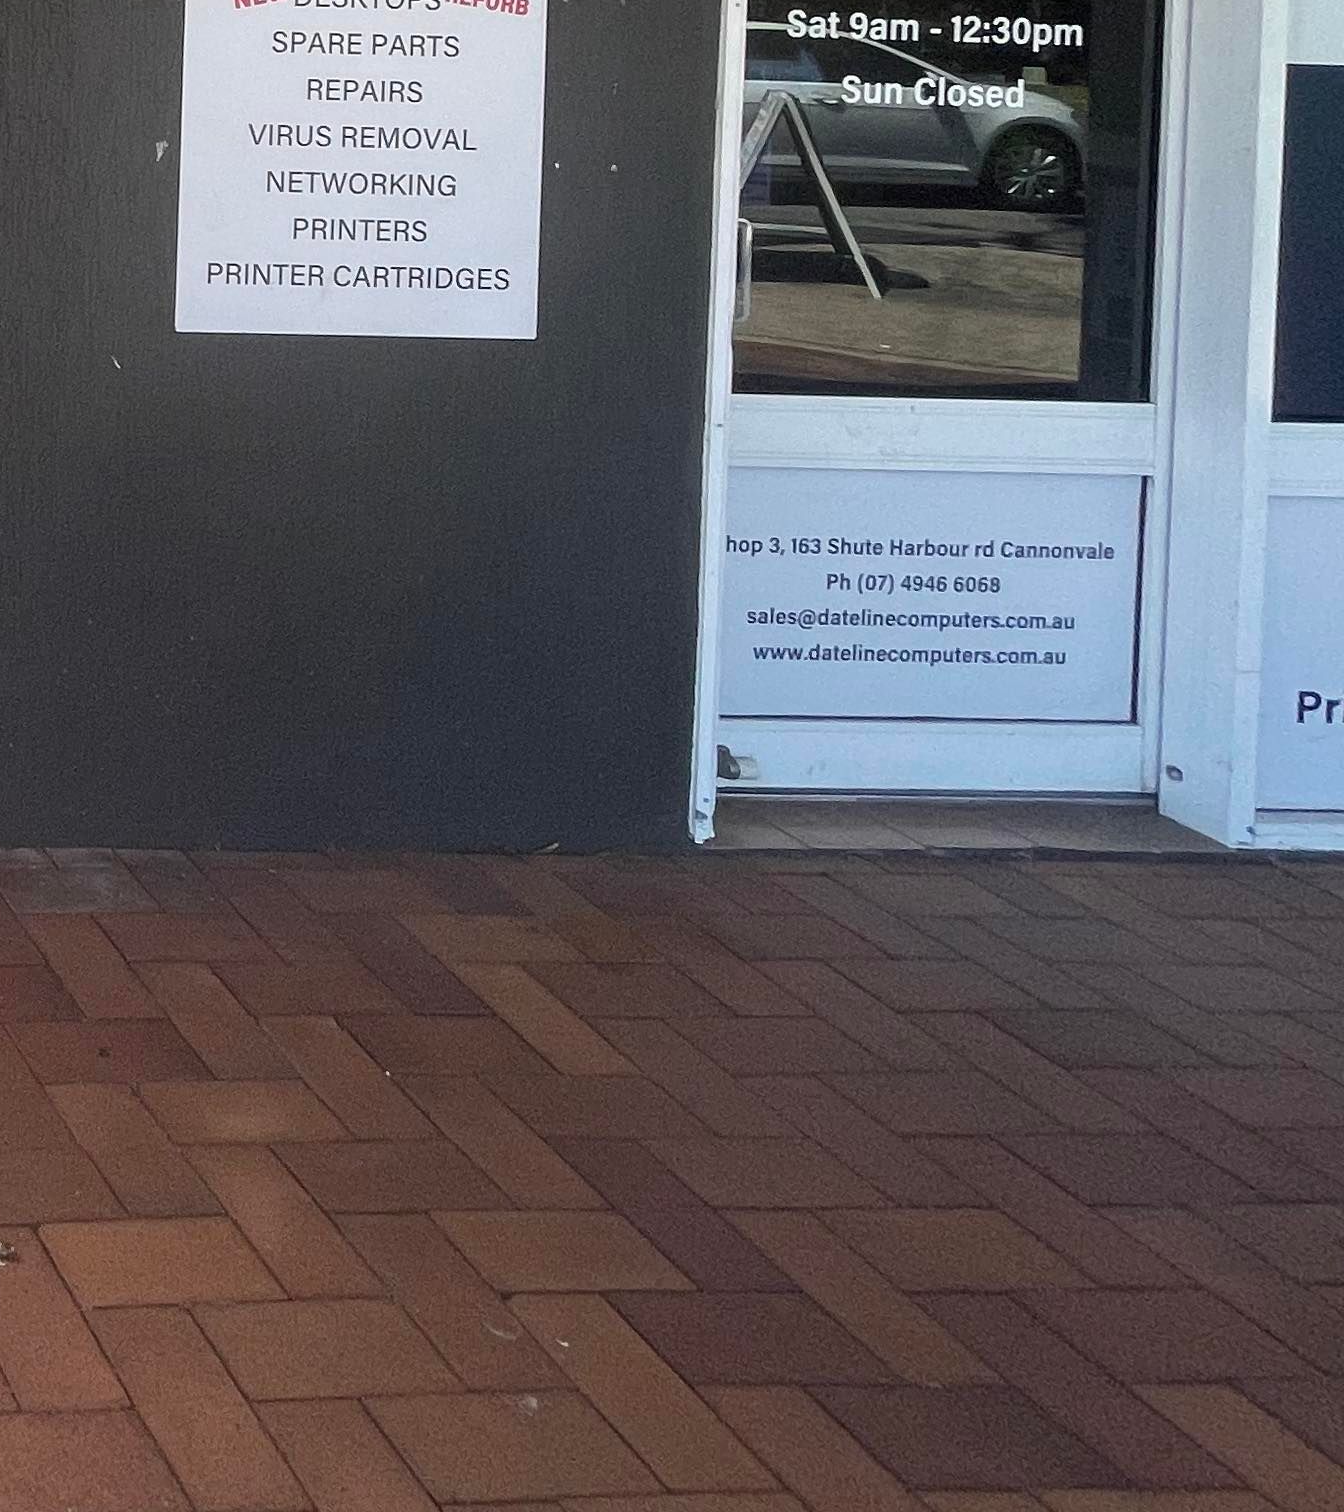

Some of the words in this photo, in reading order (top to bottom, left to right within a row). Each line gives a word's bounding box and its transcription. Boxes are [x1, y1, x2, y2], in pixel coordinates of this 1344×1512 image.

[271, 31, 362, 56] SPARE
[371, 32, 461, 58] PARTS
[786, 9, 841, 38] Sat
[849, 12, 919, 41] 9am
[951, 15, 1084, 53] 12:30pm
[306, 78, 424, 104] REPAIRS
[841, 75, 903, 104] Sun
[914, 76, 1025, 108] Closed
[248, 124, 332, 149] VIRUS
[341, 125, 477, 152] REMOVAL
[266, 170, 458, 197] NETWORKING
[292, 218, 428, 243] PRINTERS
[207, 262, 325, 288] PRINTER
[333, 264, 510, 291] CARTRIDGES
[725, 534, 763, 557] hop
[768, 537, 785, 556] 3,
[791, 537, 822, 555] 163
[827, 536, 883, 556] Shute
[889, 539, 969, 558] Harbour
[974, 540, 994, 558] rd
[1000, 541, 1114, 560] Cannonvale
[826, 572, 851, 590] Ph
[857, 573, 895, 595] (07)
[900, 575, 948, 592] 4946
[953, 576, 1001, 593] 6068
[746, 607, 1075, 632] sales@datelinecomputers.com.au
[753, 643, 1066, 667] www.datelinecomputers.com.au
[1297, 690, 1344, 724] Pr
